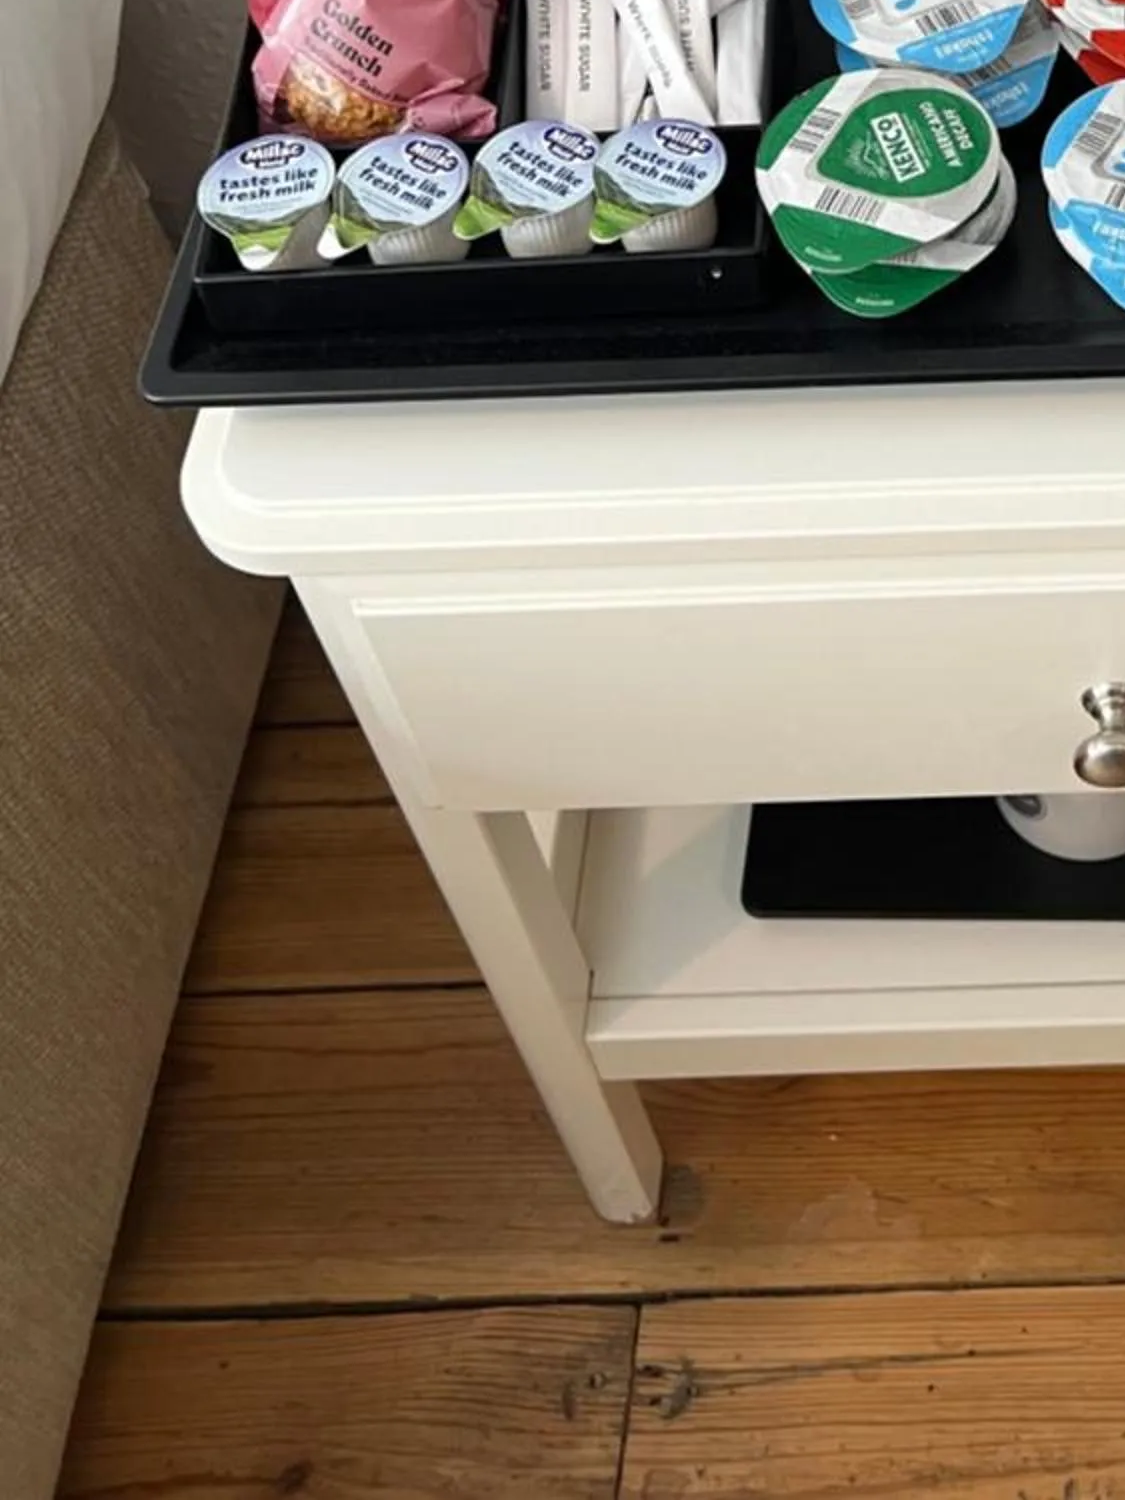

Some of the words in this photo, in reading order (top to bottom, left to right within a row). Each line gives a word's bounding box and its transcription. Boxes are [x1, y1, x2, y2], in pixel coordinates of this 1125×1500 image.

[311, 17, 382, 77] Crunch
[539, 45, 551, 91] SUGAR
[578, 44, 591, 92] SUGAR
[878, 119, 919, 177] KENCO
[919, 101, 963, 166] AMERICANO
[220, 175, 280, 189] tastes
[285, 168, 318, 181] like
[371, 156, 417, 186] tastes
[418, 179, 447, 198] like
[497, 152, 537, 180] fresh
[537, 178, 569, 197] milk
[509, 142, 554, 173] tastes
[555, 166, 583, 186] like
[615, 154, 659, 178] fresh
[660, 174, 695, 191] milk
[624, 142, 674, 168] tastes
[677, 161, 708, 180] like
[220, 188, 270, 202] fresh
[275, 181, 315, 196] milk
[359, 168, 400, 196] fresh
[400, 191, 434, 210] milk
